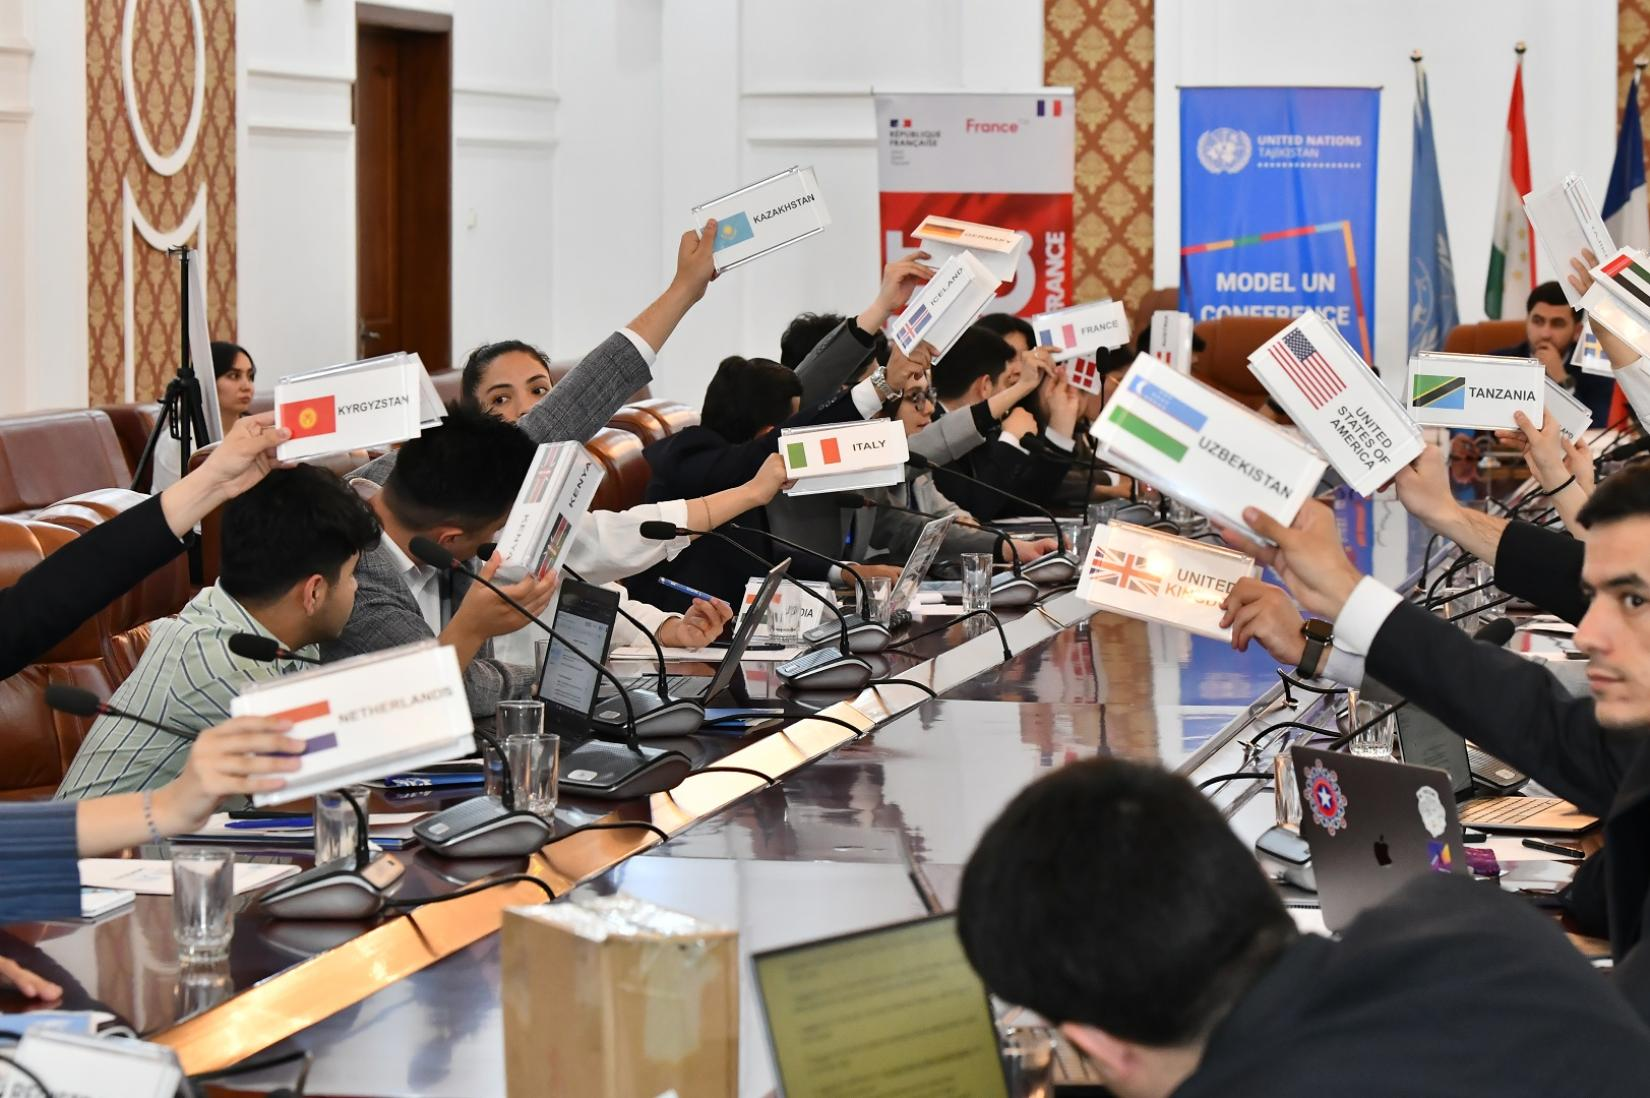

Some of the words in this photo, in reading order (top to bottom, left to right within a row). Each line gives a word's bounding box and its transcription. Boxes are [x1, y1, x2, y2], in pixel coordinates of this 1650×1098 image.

[965, 118, 1019, 133] France
[1257, 135, 1304, 147] UNITED
[1305, 135, 1361, 147] NATIONS
[753, 193, 816, 224] KAZAKHSTAN
[930, 267, 964, 306] ICELAND
[1216, 272, 1296, 292] MODEL
[1302, 272, 1336, 292] UN
[1081, 319, 1119, 336] FRANCE
[338, 395, 410, 416] KYRGYZSTAN
[1468, 387, 1536, 402] TANZANIA
[1337, 405, 1376, 449] STATES
[1373, 448, 1392, 465] OF
[1355, 406, 1393, 449] UNITED
[852, 440, 886, 452] ITALY
[1329, 419, 1375, 471] AMERICA
[1198, 436, 1294, 500] UZBEKISTAN
[568, 462, 592, 508] KENYA
[338, 687, 454, 724] NETHERLANDS
